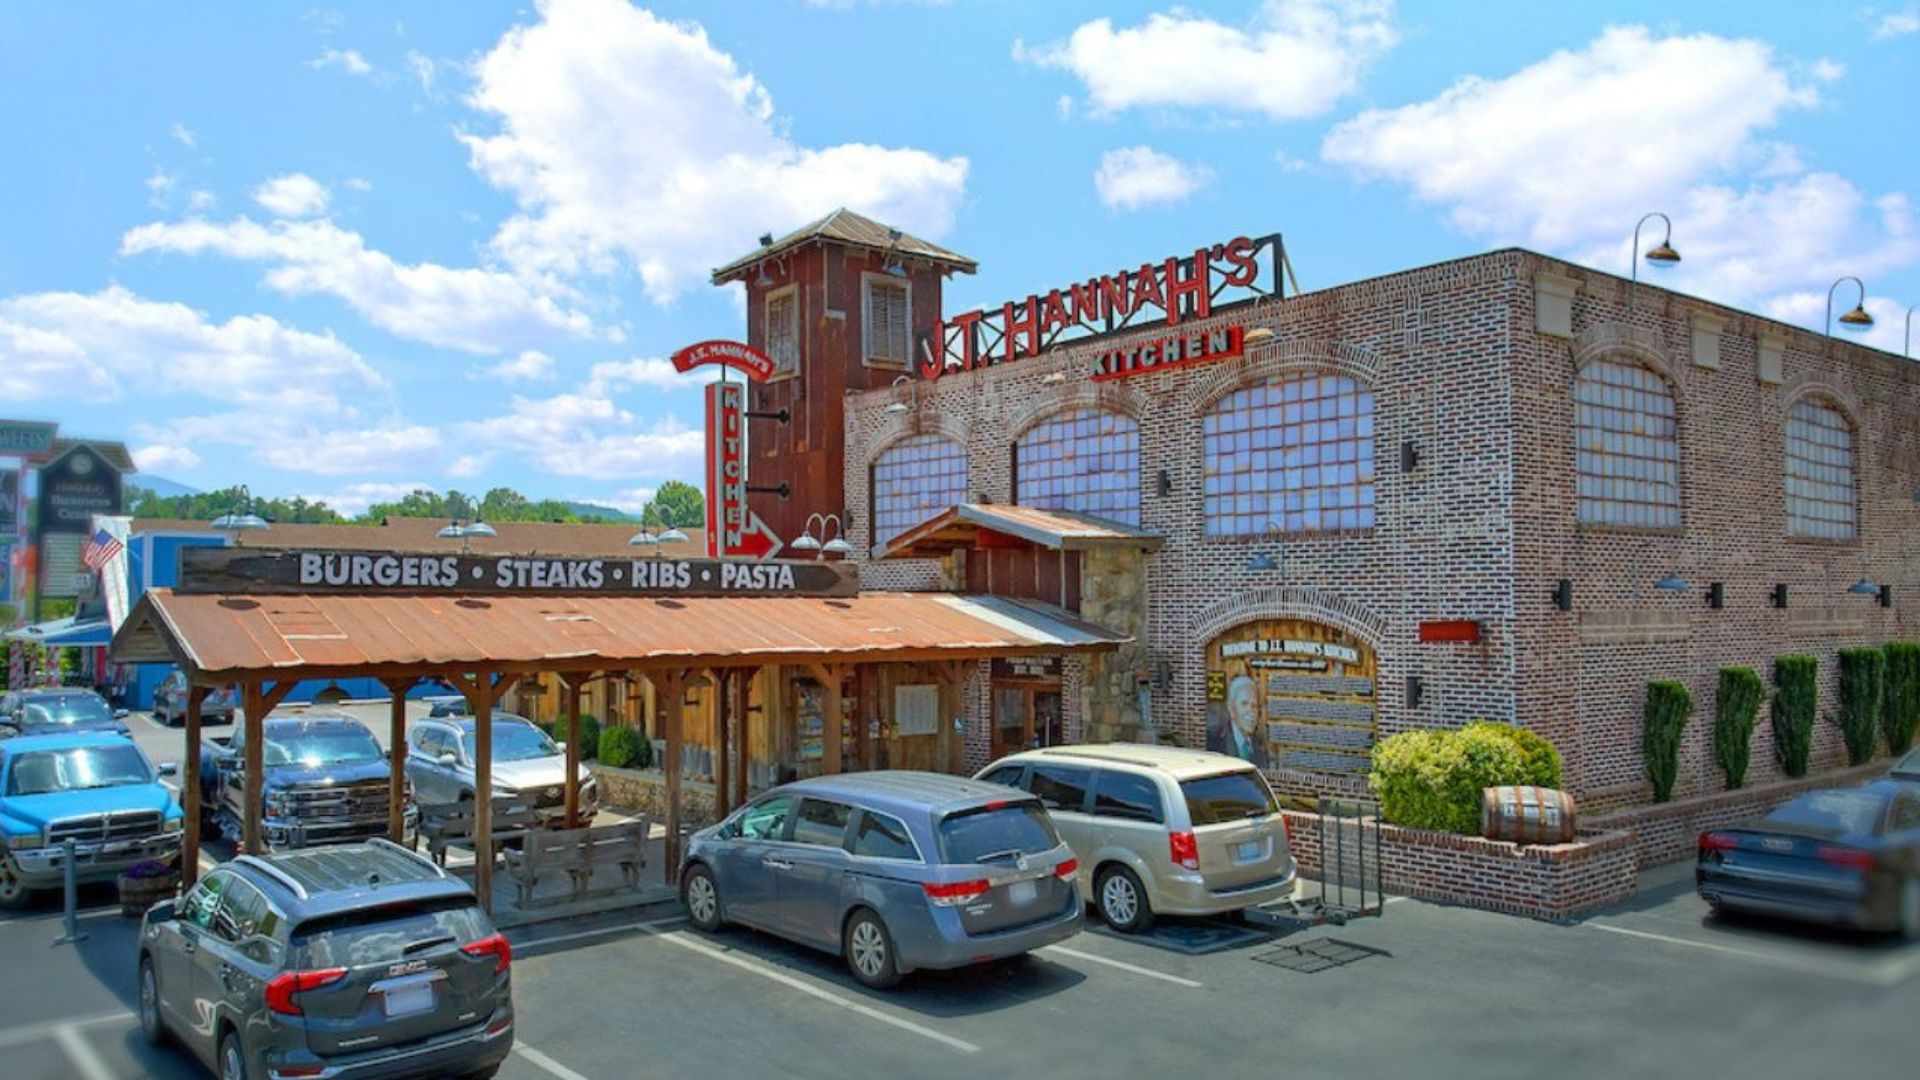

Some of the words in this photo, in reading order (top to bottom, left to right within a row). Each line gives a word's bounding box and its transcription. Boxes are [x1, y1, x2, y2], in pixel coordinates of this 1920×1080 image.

[920, 309, 990, 380] J.T.
[1004, 236, 1258, 363] HANNAH'S
[1090, 330, 1229, 376] KITCHEN
[724, 389, 742, 548] KITCHEN
[300, 553, 459, 587] BURGERS
[496, 557, 604, 588] STEAKS
[631, 560, 691, 589] RIBS
[720, 563, 796, 590] PASTA
